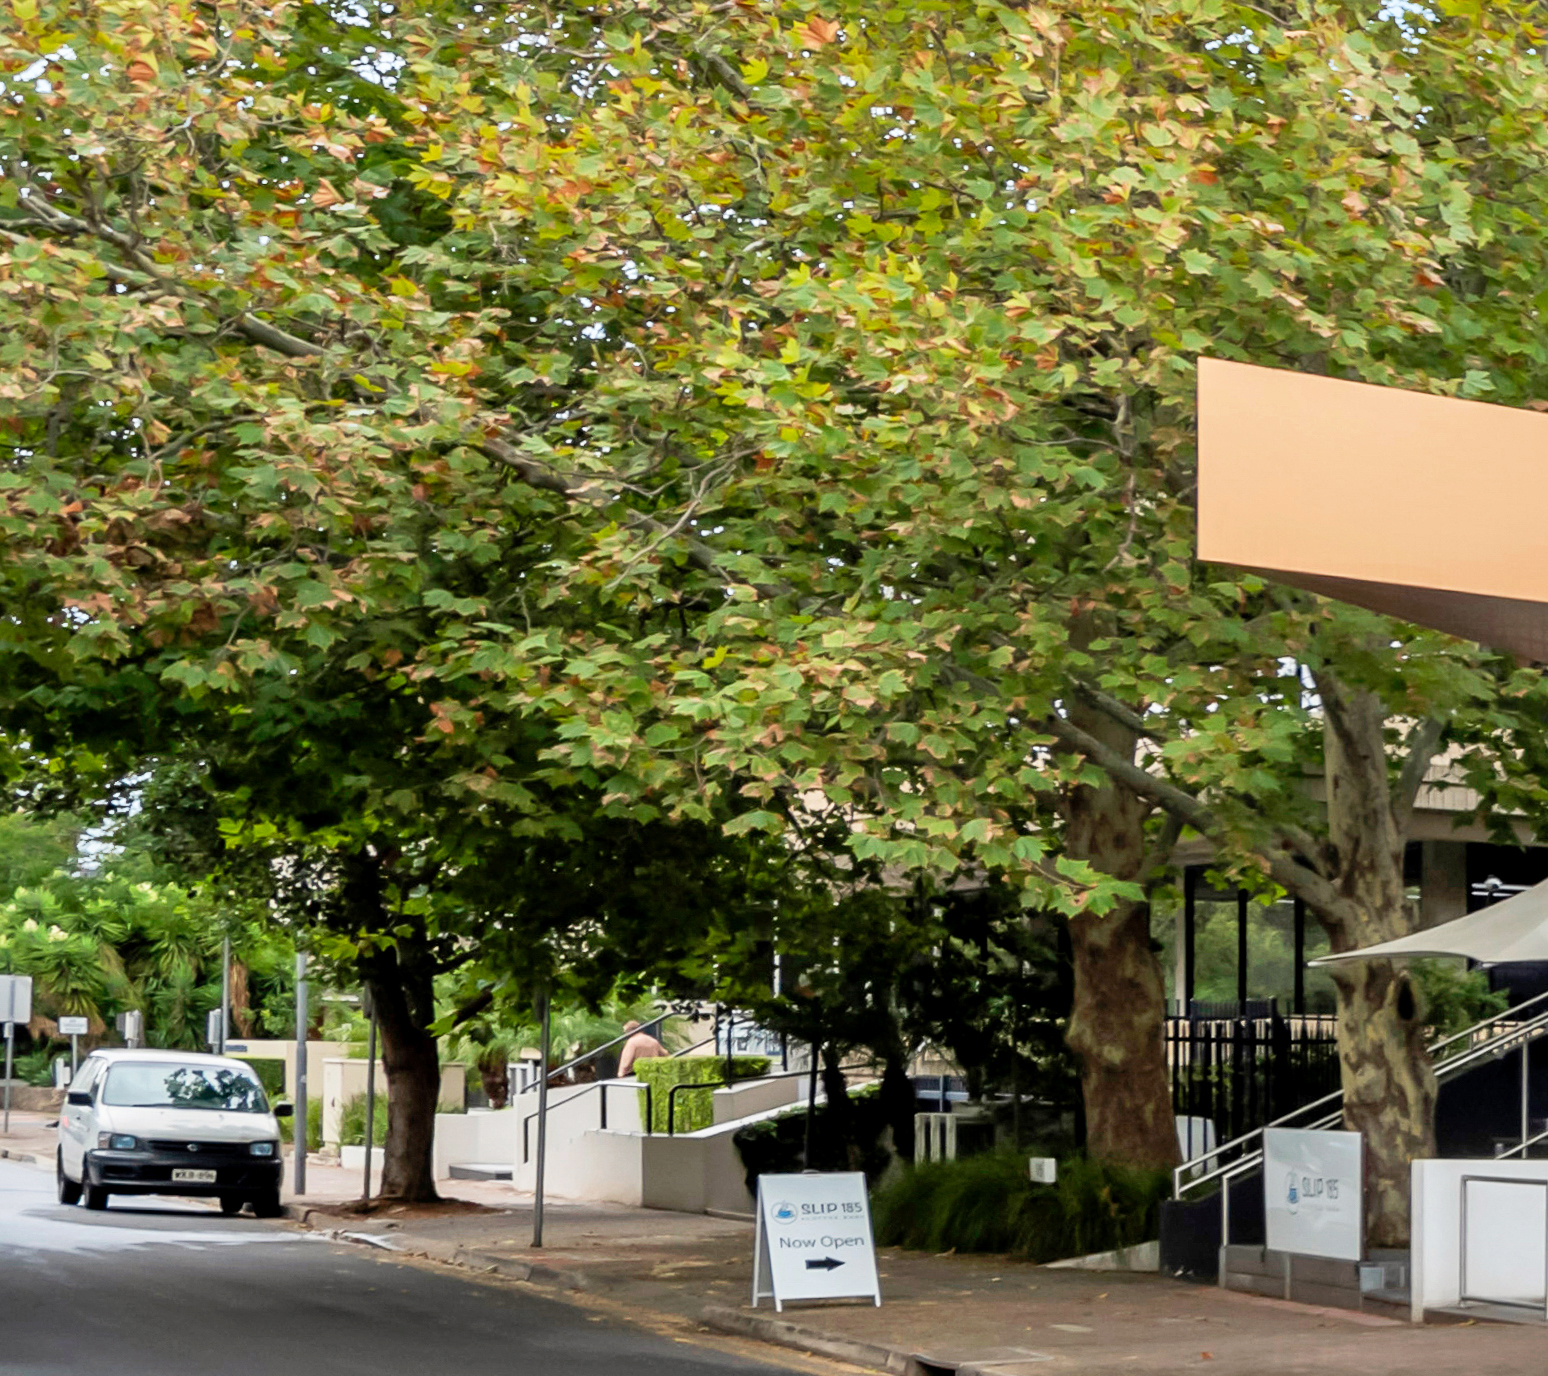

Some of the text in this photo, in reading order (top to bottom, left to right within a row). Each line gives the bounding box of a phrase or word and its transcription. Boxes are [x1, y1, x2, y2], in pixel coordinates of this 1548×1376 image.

[801, 1201, 863, 1216] SLIP 185
[779, 1235, 865, 1250] Now Open
